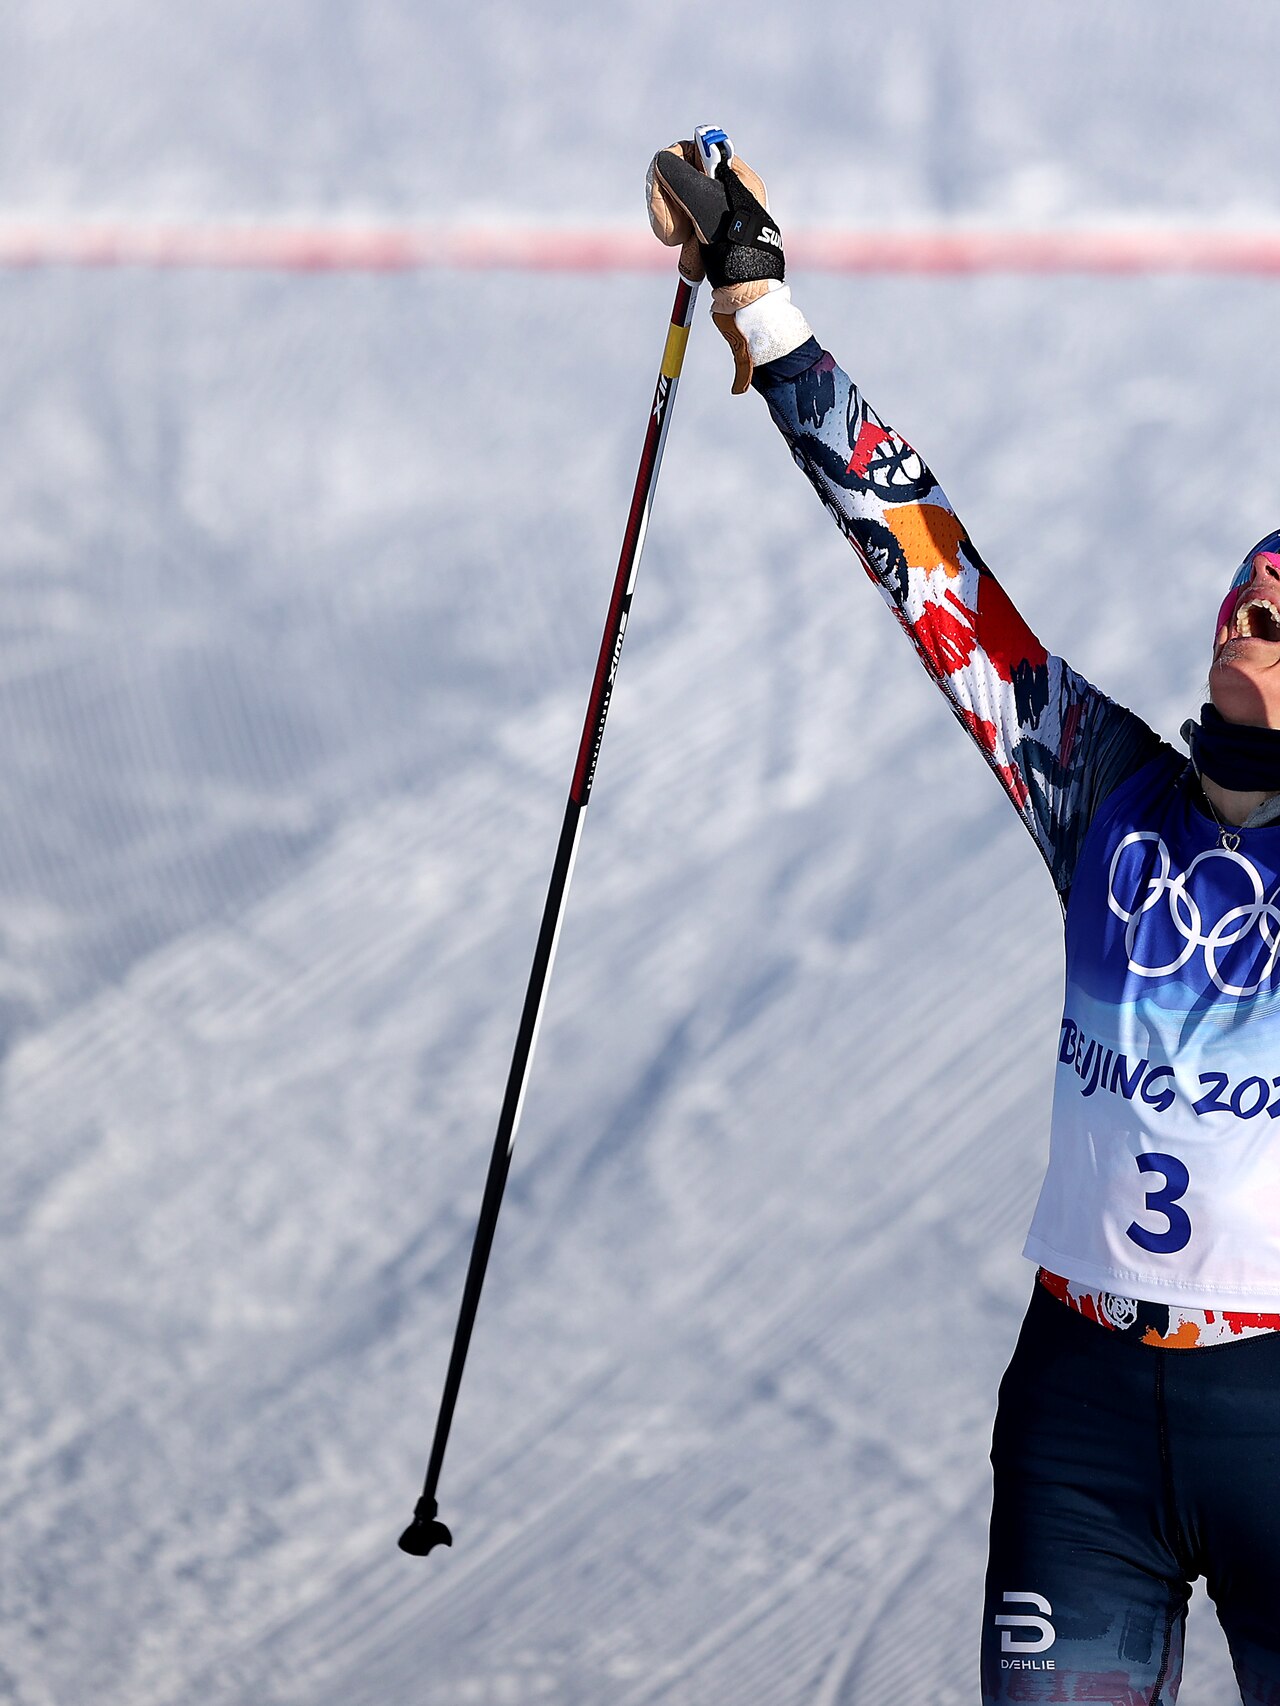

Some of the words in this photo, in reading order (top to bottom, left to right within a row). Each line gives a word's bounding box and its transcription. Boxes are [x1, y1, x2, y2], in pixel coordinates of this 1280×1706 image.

[733, 220, 743, 232] R
[757, 226, 783, 251] SWI
[587, 691, 611, 790] AERODYNAMICS
[1058, 1018, 1176, 1113] BEIJING
[1125, 1152, 1192, 1254] 3
